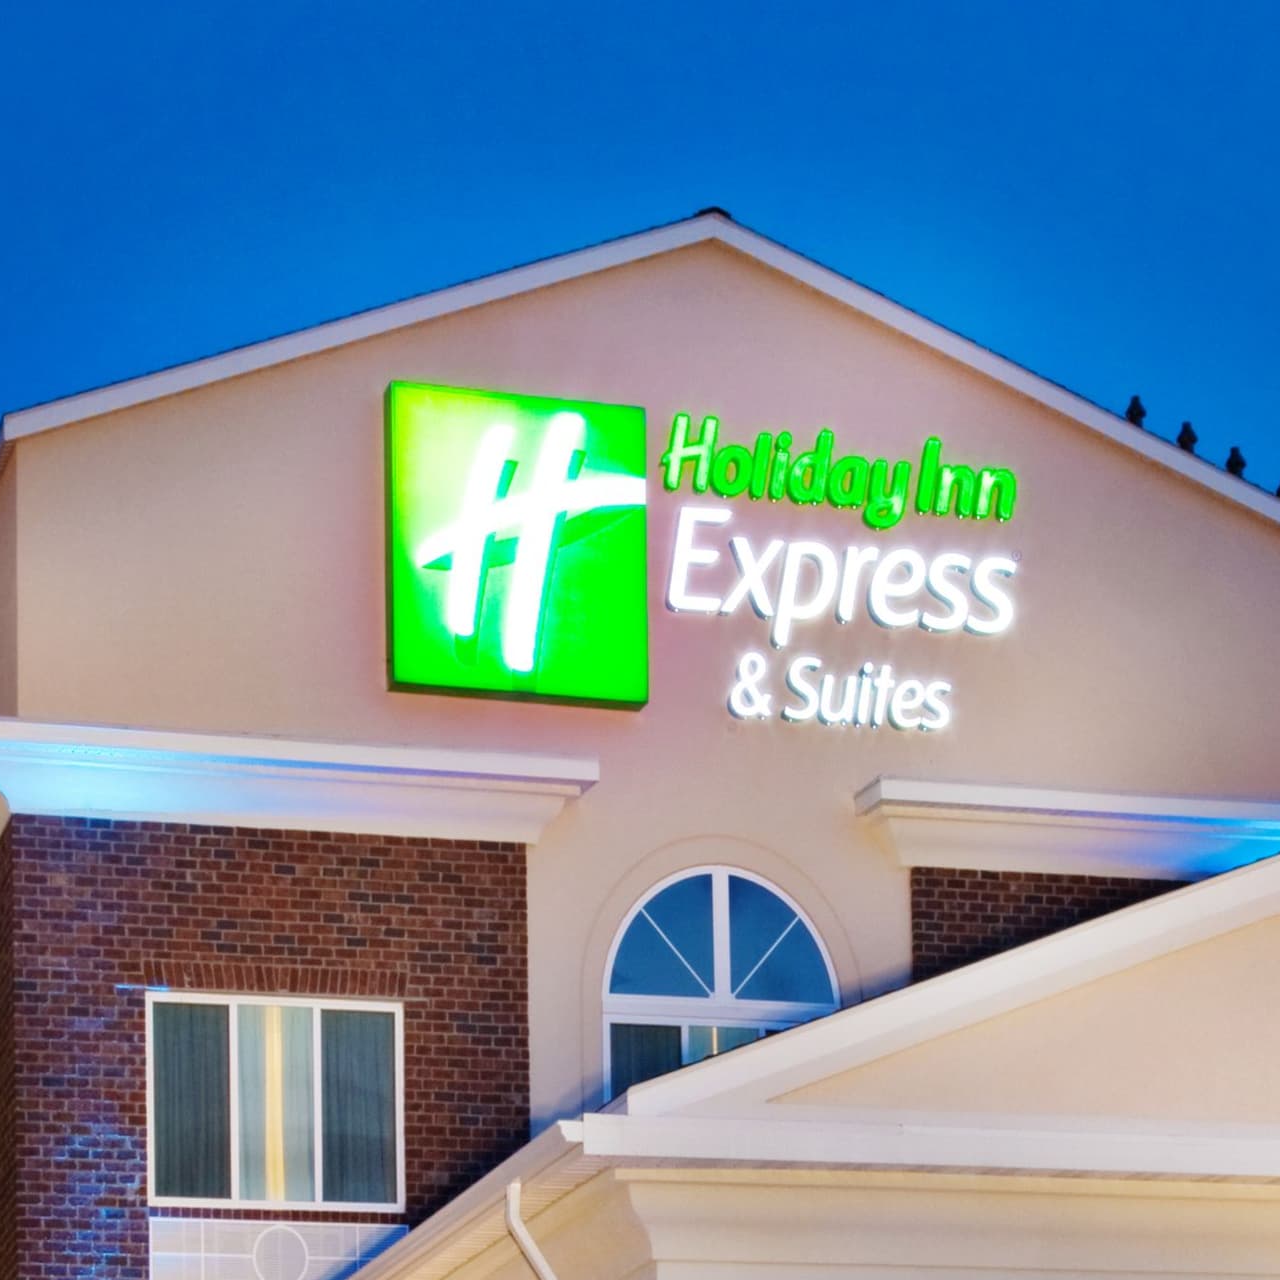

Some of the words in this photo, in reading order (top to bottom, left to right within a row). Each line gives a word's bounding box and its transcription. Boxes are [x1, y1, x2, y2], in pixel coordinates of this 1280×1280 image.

[662, 413, 910, 529] Holiday
[915, 437, 1017, 521] Inn
[667, 505, 1018, 647] Express
[728, 651, 773, 719] &
[782, 656, 952, 731] Suites
